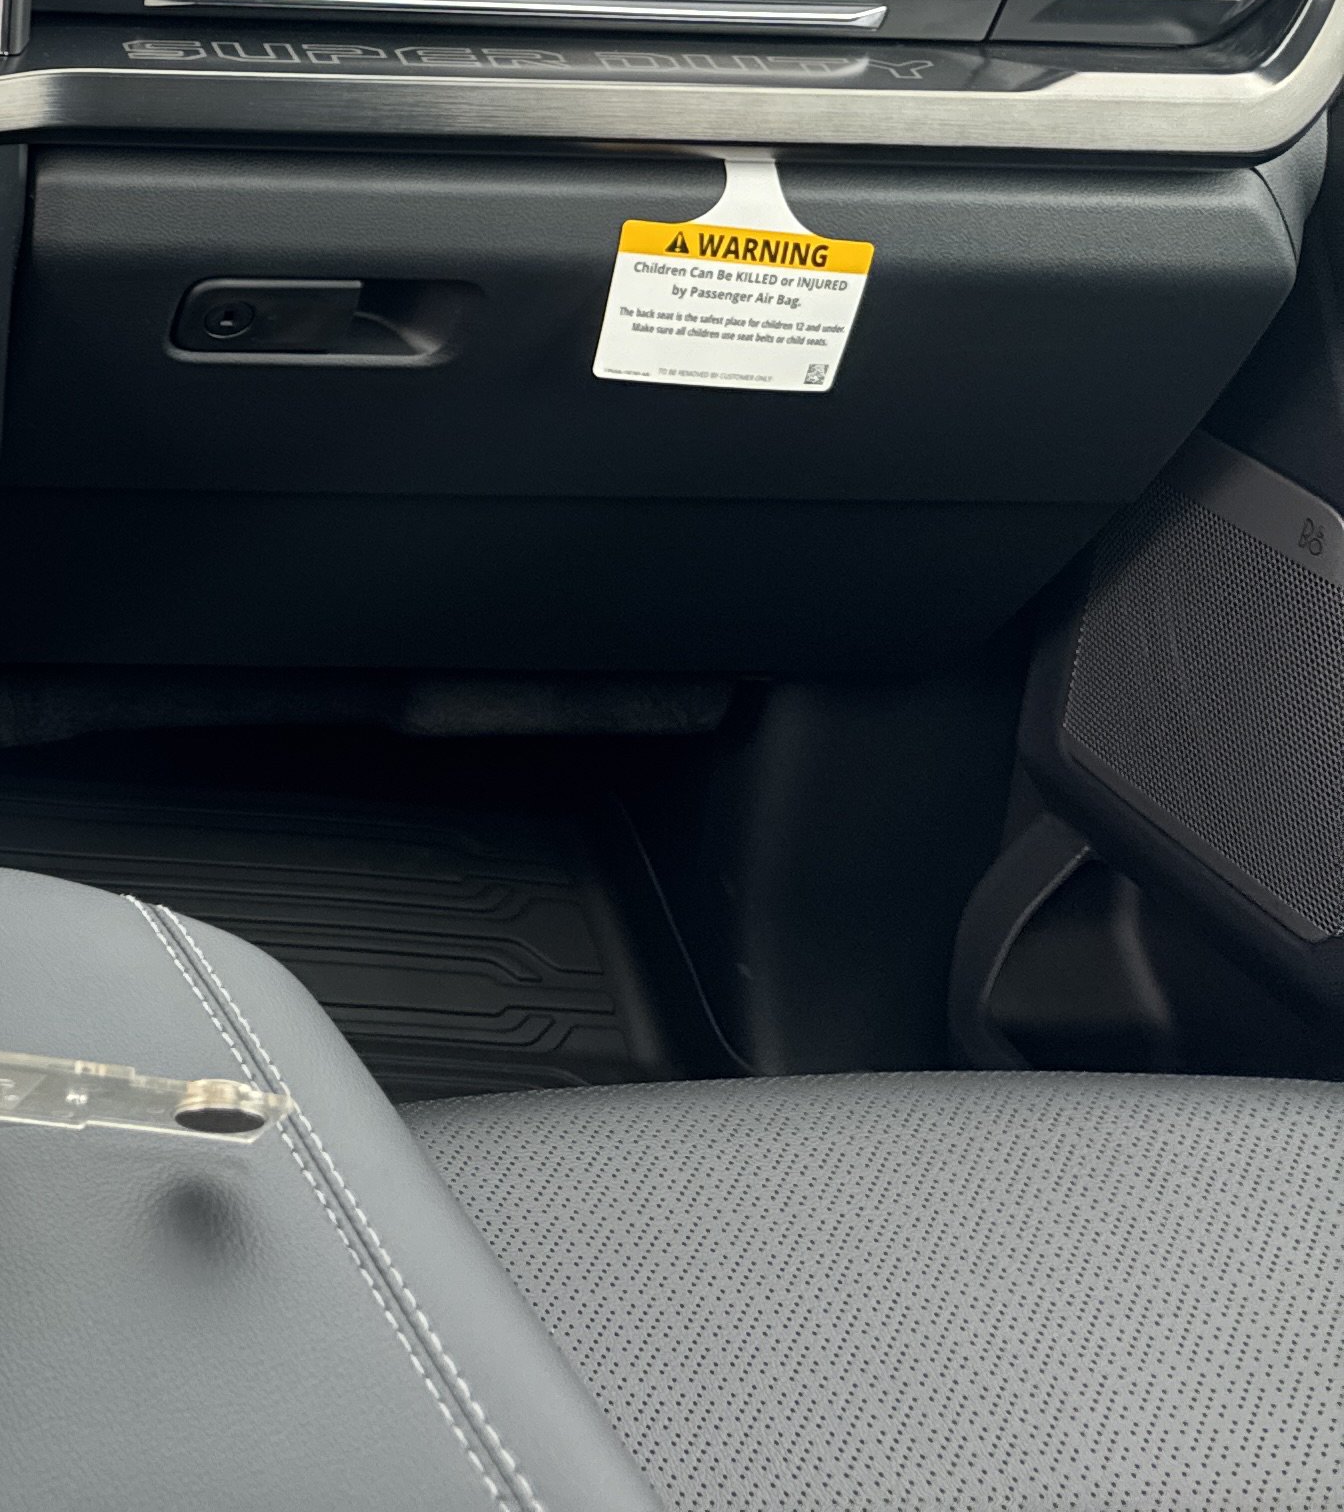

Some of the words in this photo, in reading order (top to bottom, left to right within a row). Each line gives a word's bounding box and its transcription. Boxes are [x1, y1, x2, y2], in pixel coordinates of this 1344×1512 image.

[122, 38, 567, 70] SUPER
[595, 51, 934, 80] DUTY
[697, 233, 829, 268] WARNING
[634, 261, 686, 277] Children
[690, 266, 714, 279] Can
[717, 270, 732, 281] Be
[736, 271, 778, 285] KILLED
[781, 277, 794, 287] or
[796, 277, 848, 291] INJURED
[671, 285, 687, 299] by
[689, 287, 753, 304] Passenger
[755, 293, 774, 304] Air
[776, 295, 801, 309] Bag.
[620, 306, 634, 317] The
[636, 308, 655, 319] back
[656, 311, 674, 321] seat
[676, 313, 682, 321] is
[684, 313, 698, 322] the
[700, 315, 723, 325] safest
[724, 316, 746, 327] place
[748, 318, 760, 327] for
[761, 319, 793, 331] children
[795, 322, 804, 332] 12
[805, 324, 821, 333] and
[632, 322, 655, 333] Make
[656, 326, 674, 335] sure
[675, 327, 686, 335] all
[687, 328, 720, 339] children
[721, 332, 736, 340] use
[737, 333, 754, 341] seat
[755, 333, 775, 344] belts
[786, 335, 805, 345] child
